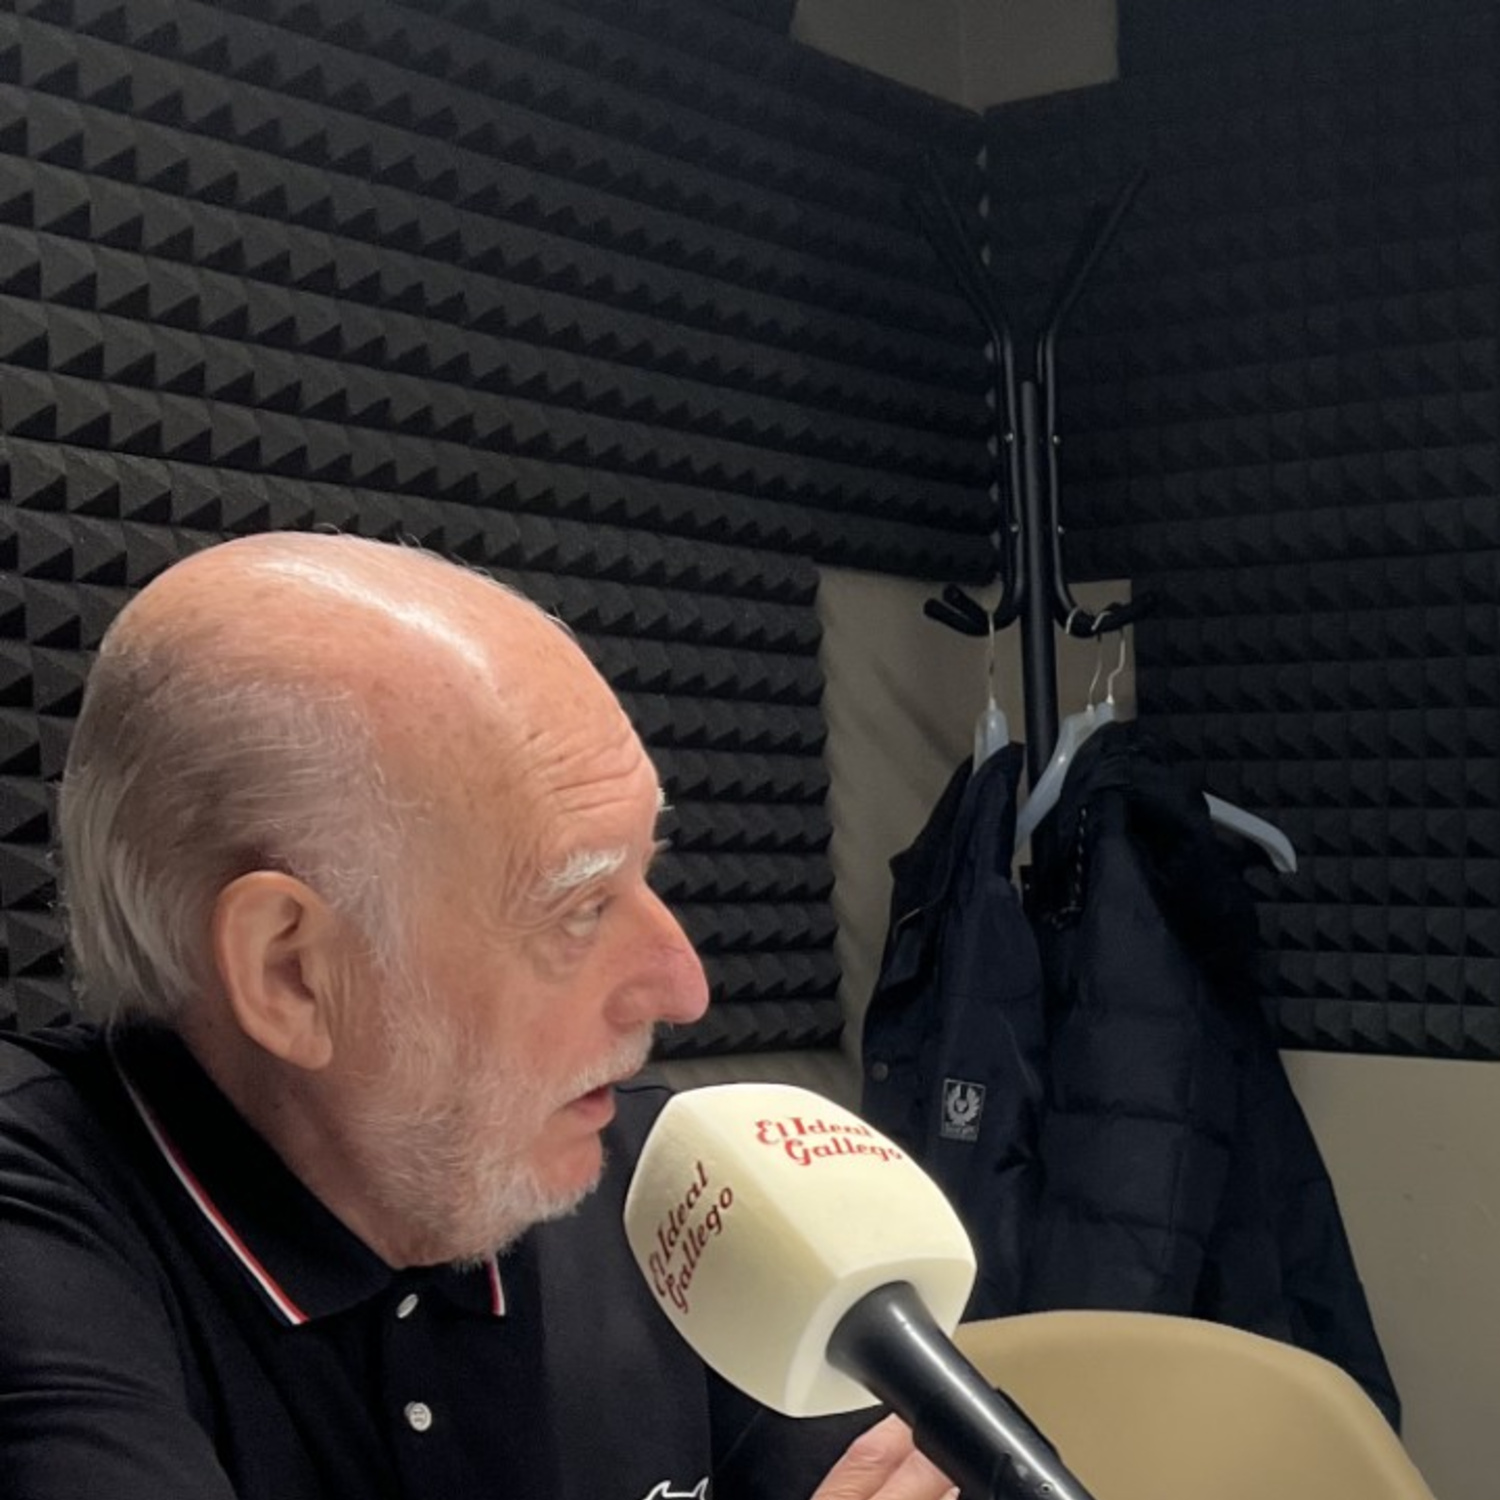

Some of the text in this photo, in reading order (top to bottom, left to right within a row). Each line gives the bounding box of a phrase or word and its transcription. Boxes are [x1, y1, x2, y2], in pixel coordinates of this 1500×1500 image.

[755, 1116, 873, 1145] El Ideal
[784, 1136, 903, 1166] Gallego
[649, 1160, 708, 1298] El Ideal
[665, 1186, 733, 1315] Gallego
